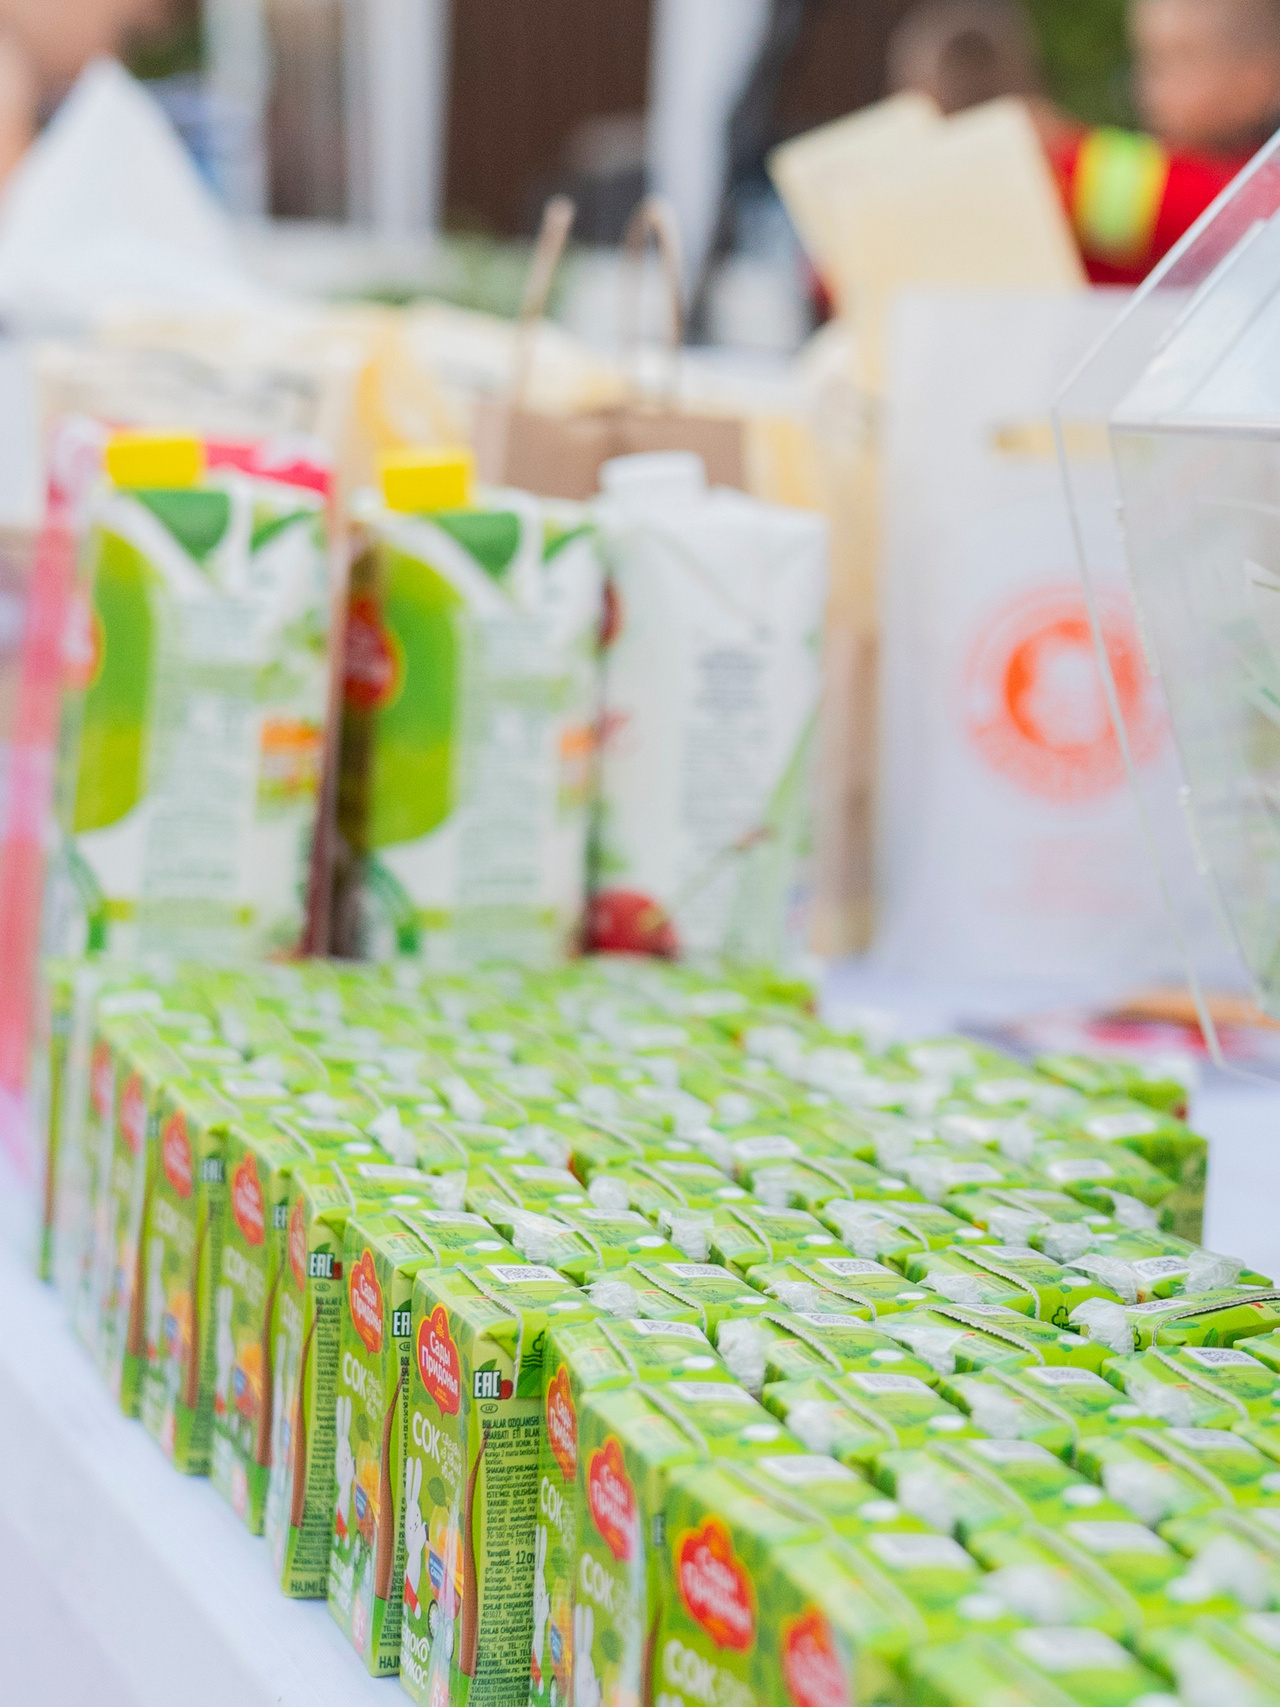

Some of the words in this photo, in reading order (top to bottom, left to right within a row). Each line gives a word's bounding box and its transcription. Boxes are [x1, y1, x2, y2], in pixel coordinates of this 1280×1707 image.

[309, 1253, 333, 1277] EAC
[359, 1274, 377, 1307] Сады
[394, 1312, 411, 1336] EA
[430, 1331, 451, 1367] Сады
[343, 1352, 366, 1400] СОК
[421, 1345, 459, 1397] Придонья
[474, 1372, 500, 1397] EAC
[412, 1411, 440, 1464] СОК
[541, 1476, 563, 1532] СОК
[515, 1551, 526, 1564] 12
[580, 1553, 614, 1613] СОК
[662, 1637, 718, 1704] СОК
